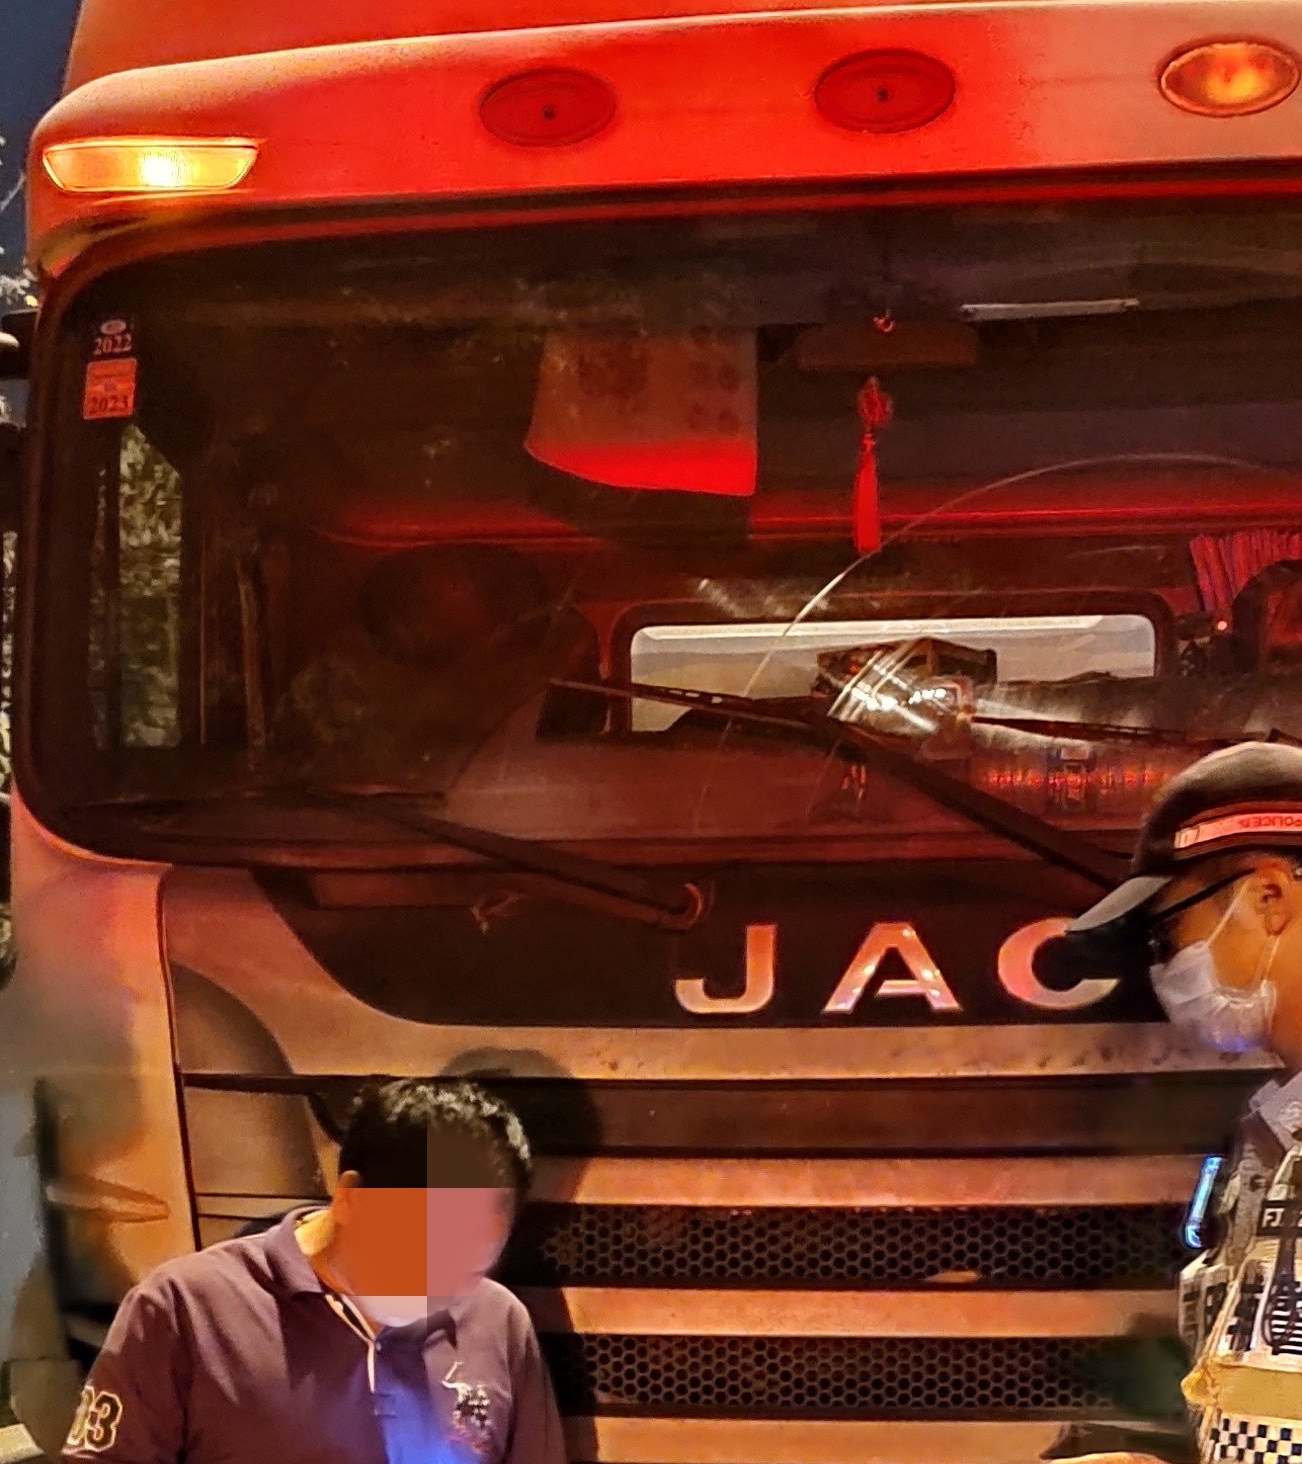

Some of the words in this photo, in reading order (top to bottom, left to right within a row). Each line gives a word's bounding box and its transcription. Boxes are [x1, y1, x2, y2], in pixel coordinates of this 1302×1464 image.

[94, 334, 132, 355] 2022
[88, 395, 129, 414] 2023
[675, 916, 1120, 1015] JAC
